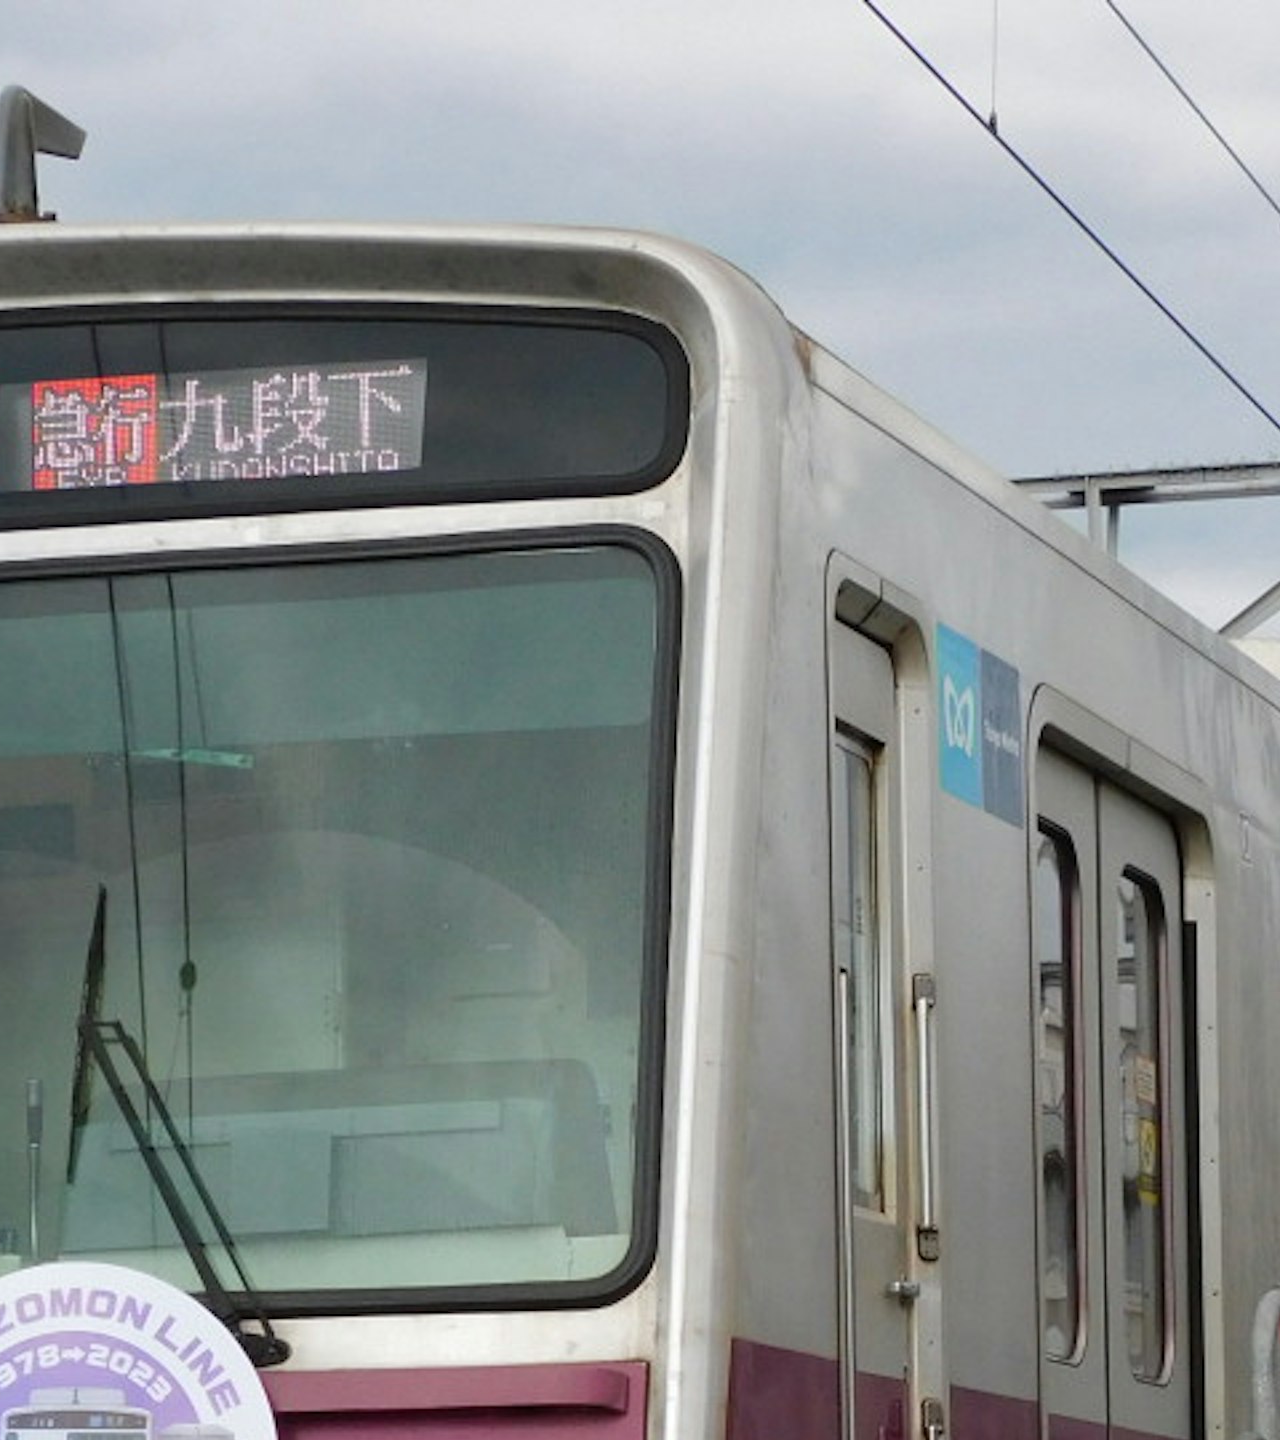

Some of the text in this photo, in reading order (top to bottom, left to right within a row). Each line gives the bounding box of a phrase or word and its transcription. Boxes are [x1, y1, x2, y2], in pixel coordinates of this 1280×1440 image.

[33, 364, 414, 468] 急行 九段下
[154, 1315, 242, 1417] LINE
